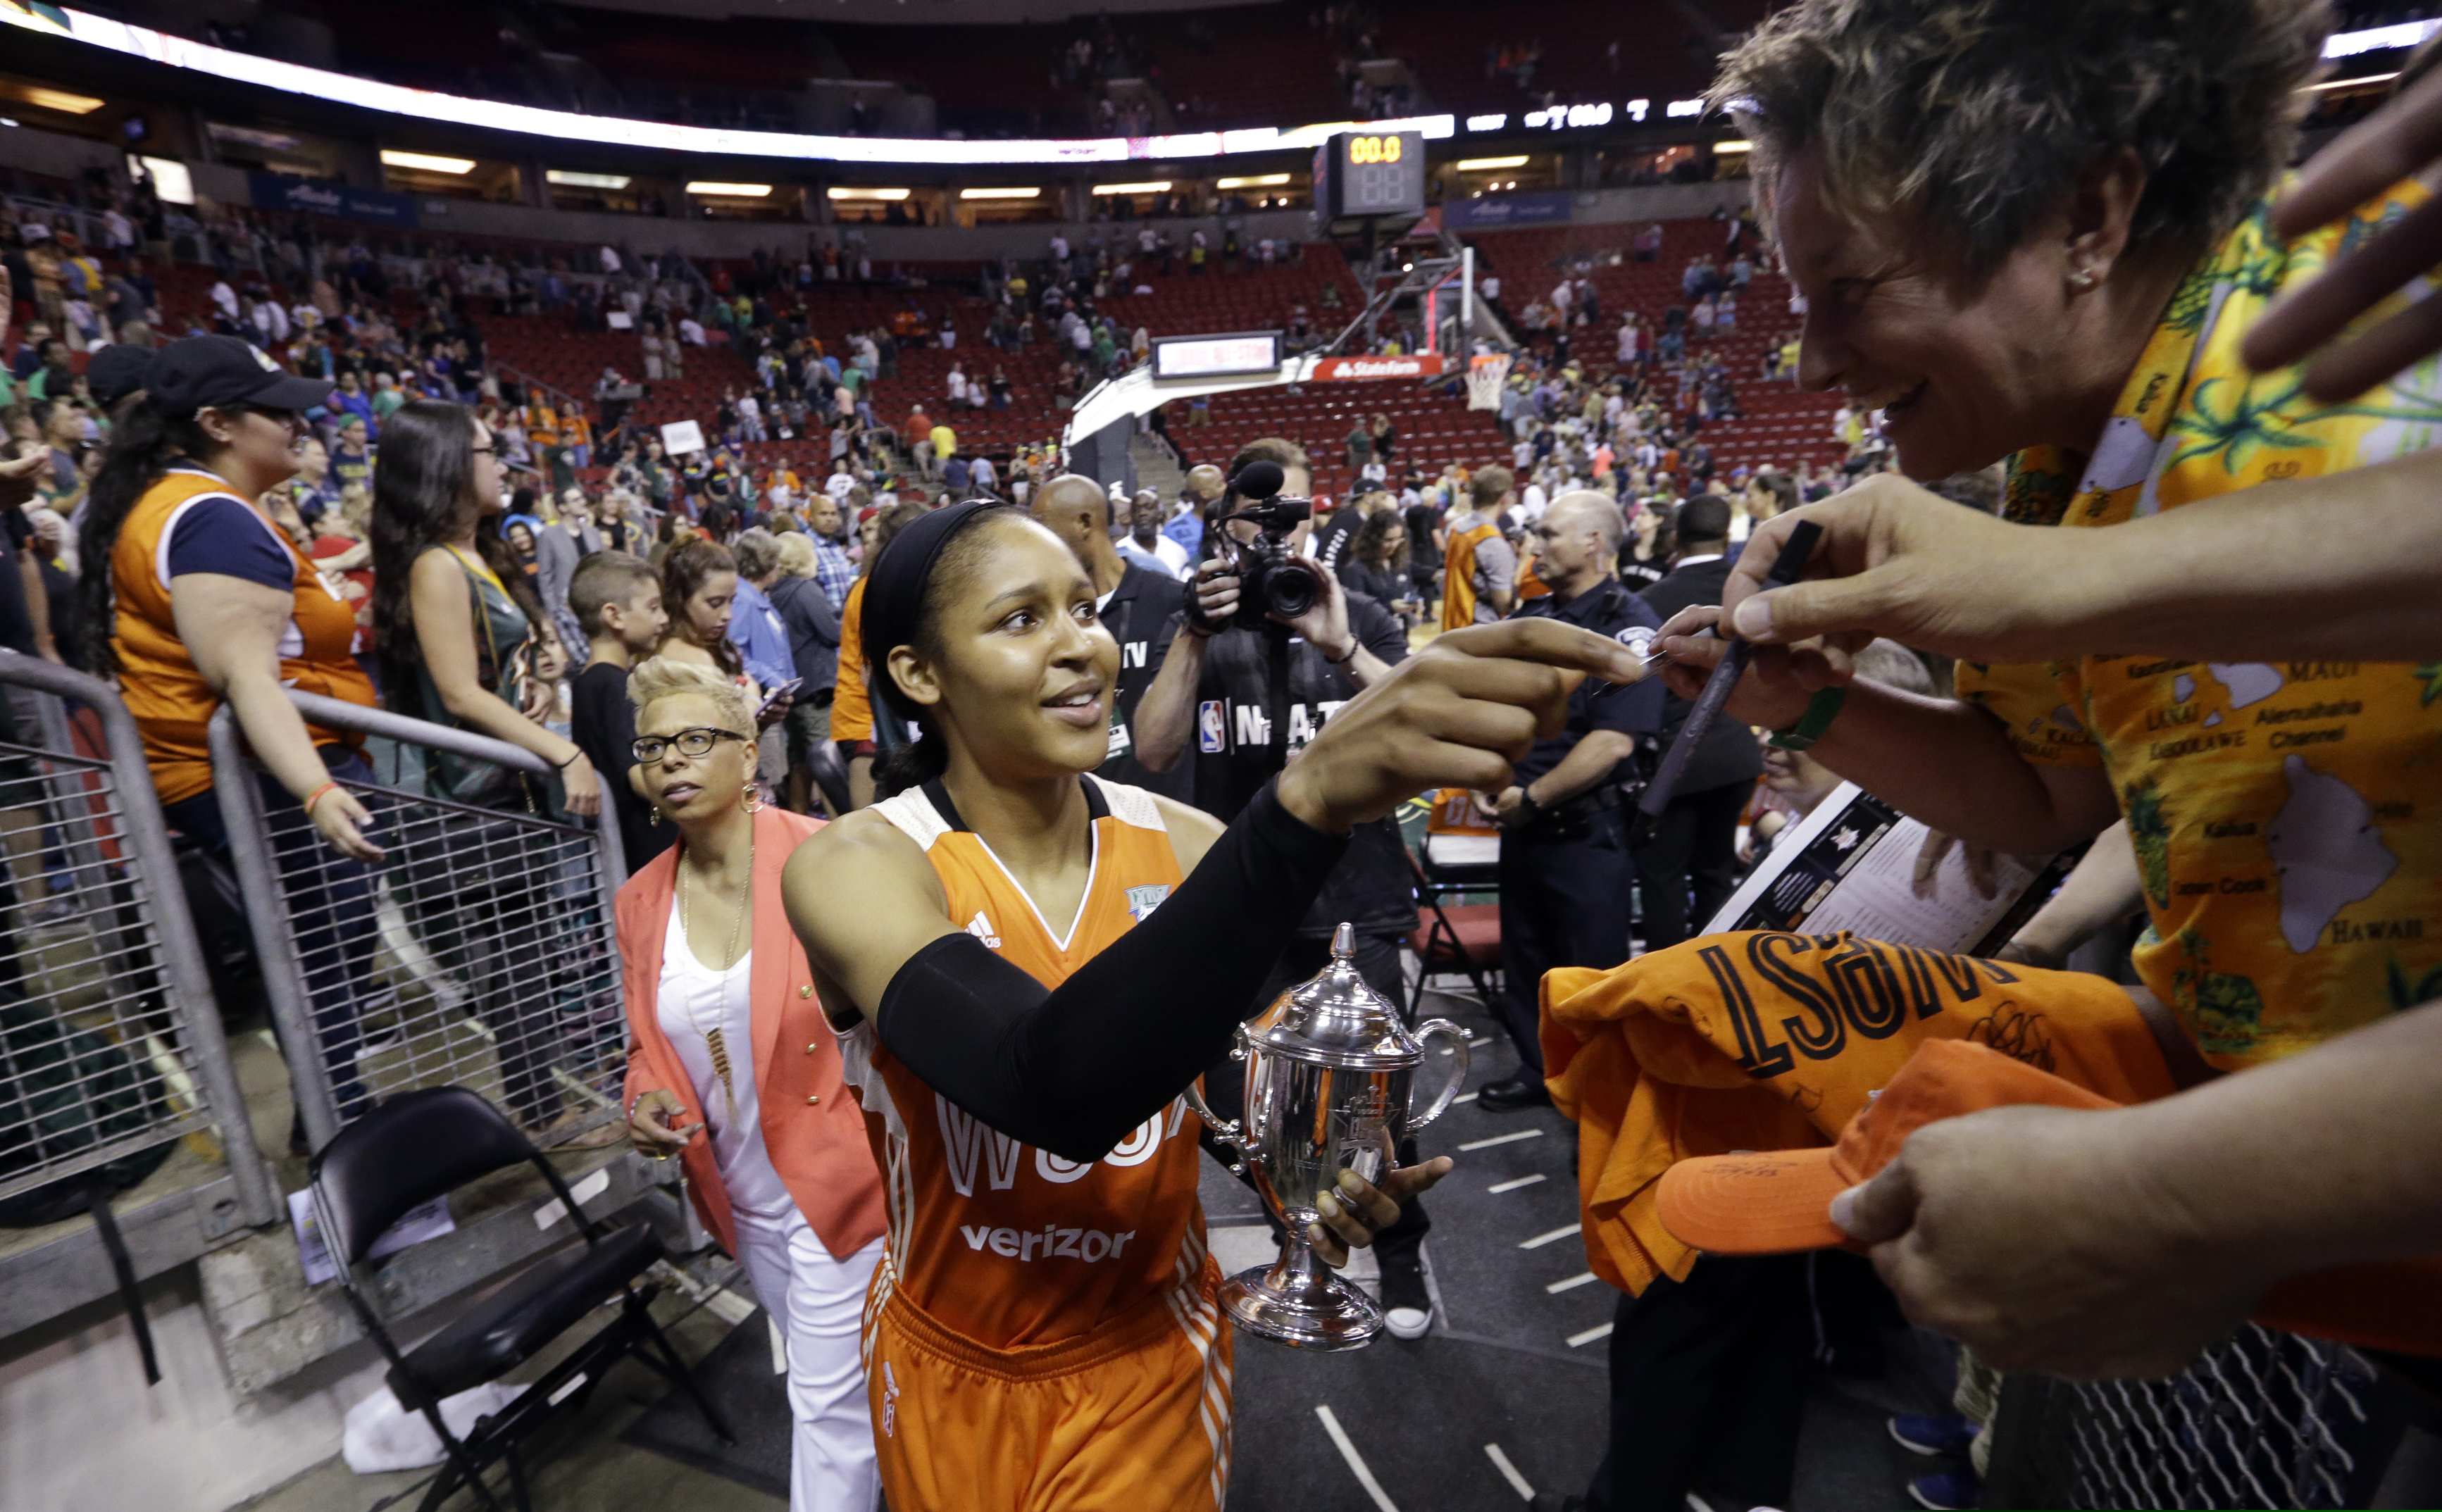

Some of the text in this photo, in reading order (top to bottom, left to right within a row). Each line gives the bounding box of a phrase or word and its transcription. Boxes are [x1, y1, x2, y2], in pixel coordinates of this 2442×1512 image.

[1350, 135, 1402, 164] 00.0
[1235, 704, 1311, 746] NA
[2331, 918, 2424, 945] HAWAII
